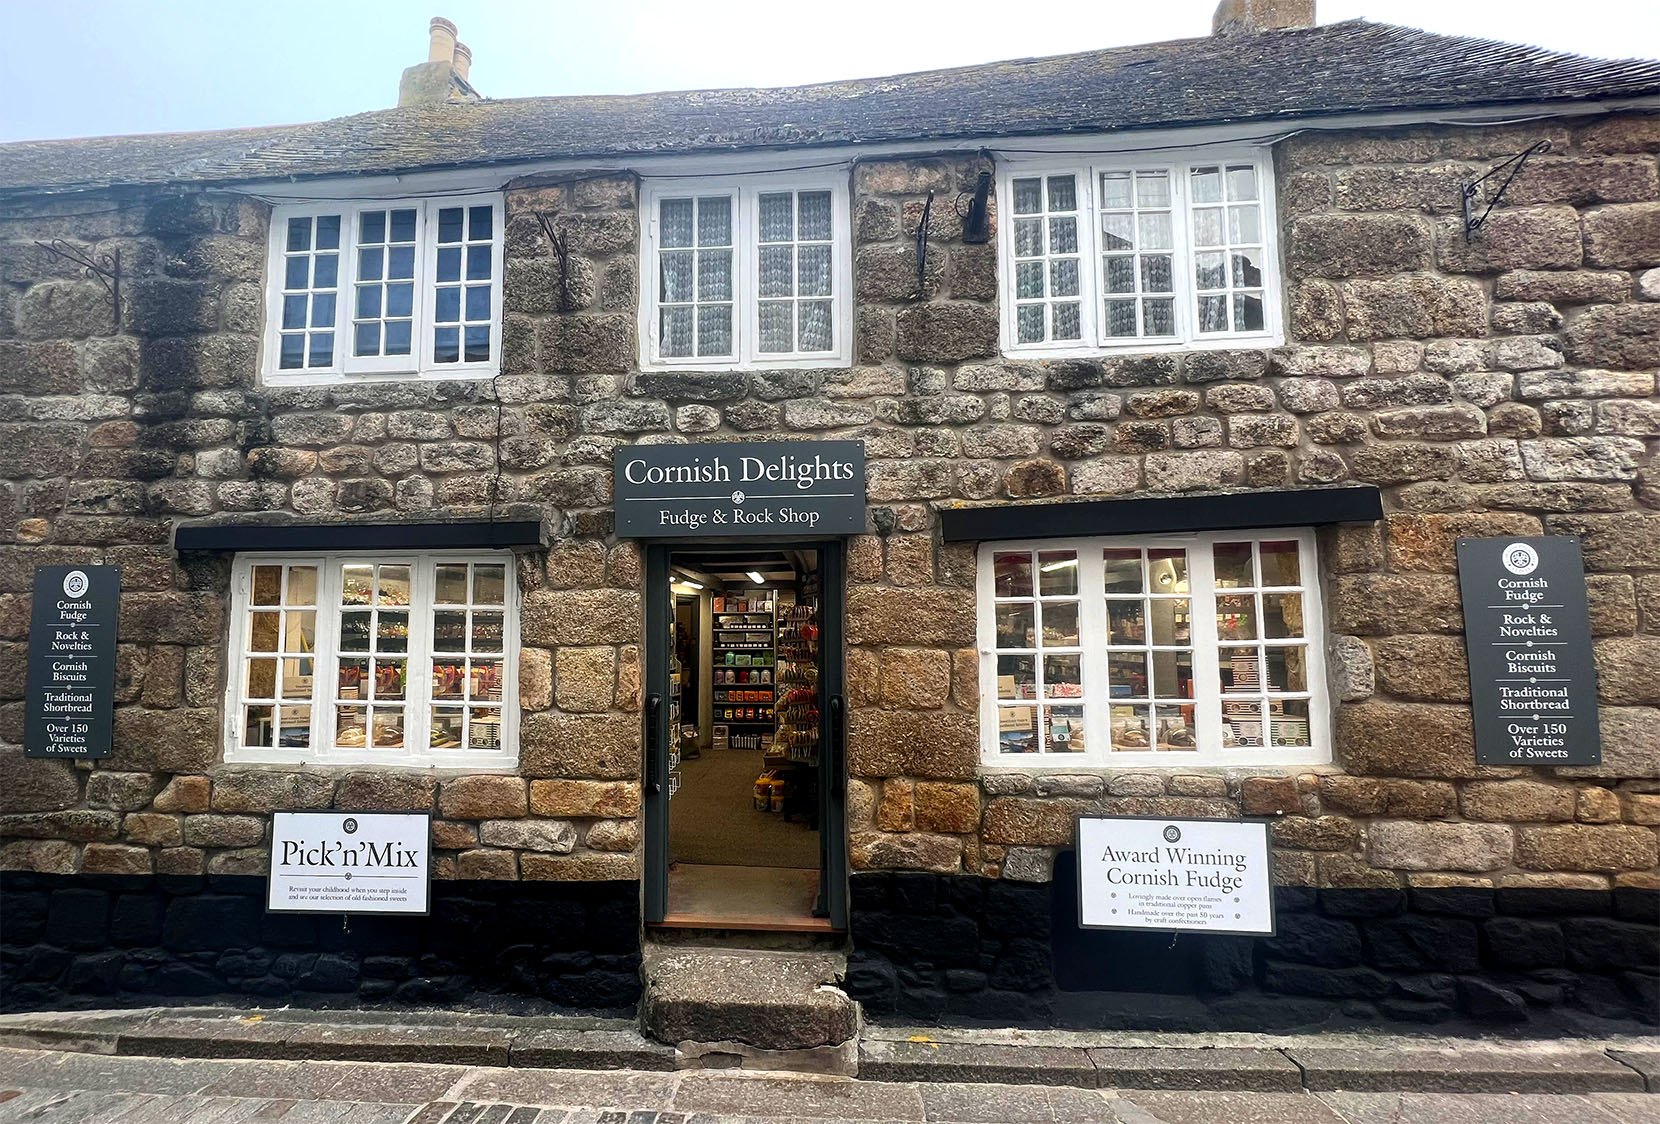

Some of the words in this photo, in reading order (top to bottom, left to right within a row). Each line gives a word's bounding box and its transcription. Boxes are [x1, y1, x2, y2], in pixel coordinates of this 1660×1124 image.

[624, 457, 731, 484] Cornish
[739, 455, 854, 489] Delights
[659, 509, 708, 529] Fudge
[712, 509, 728, 524] &
[733, 508, 774, 524] Rock
[778, 507, 820, 528] Shop
[1498, 578, 1548, 589] Cornish
[1505, 590, 1544, 603] Fudge
[57, 601, 92, 610] Cornish
[60, 611, 87, 622] Fudge
[1503, 614, 1536, 625] Rock
[1540, 614, 1552, 624] &
[55, 631, 78, 640] Rock
[80, 631, 89, 640] &
[1500, 626, 1558, 637] Novelties
[51, 641, 92, 650] Novelties
[1506, 650, 1556, 661] Cornish
[52, 662, 88, 671] Cornish
[1508, 663, 1556, 673] Biscuits
[53, 672, 87, 681] Biscuits
[44, 692, 92, 702] Traditional
[1499, 687, 1568, 698] Traditional
[44, 703, 92, 712] Shortbread
[1500, 699, 1569, 710] Shortbread
[46, 724, 68, 733] Over
[71, 724, 88, 733] 150
[1508, 724, 1538, 735] Over
[1543, 724, 1567, 734] 150
[49, 734, 85, 743] Varieties
[1512, 736, 1564, 746] Varieties
[46, 744, 55, 753] of
[58, 744, 87, 753] Sweets
[1509, 748, 1523, 758] of
[1526, 748, 1568, 758] Sweets
[1101, 845, 1160, 863] Award
[1165, 847, 1247, 873] Winning
[1107, 867, 1178, 887] Cornish
[1186, 870, 1244, 894] Fudge
[362, 894, 389, 902] fashioned
[1128, 892, 1154, 901] Lovingly
